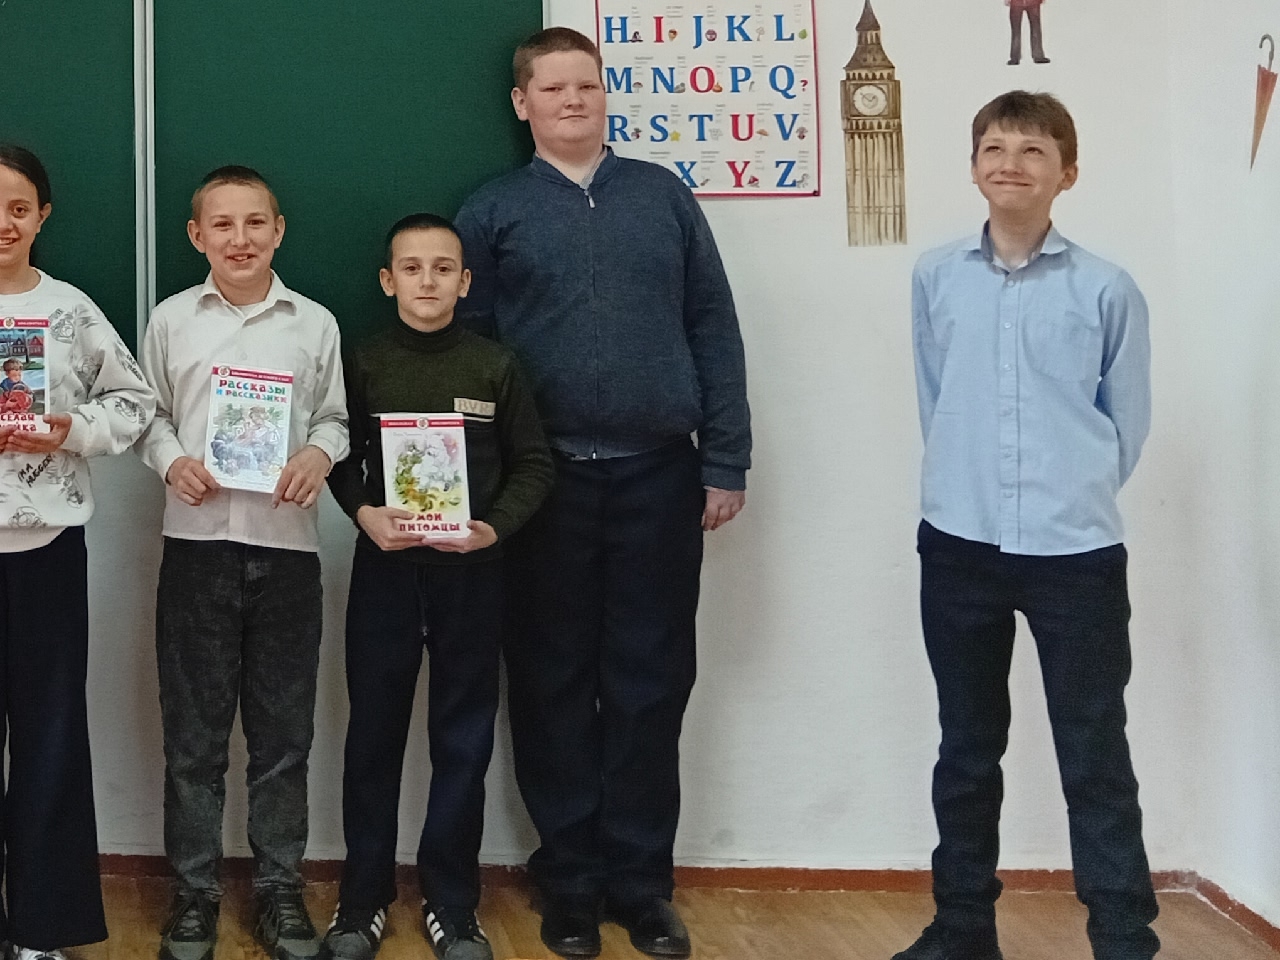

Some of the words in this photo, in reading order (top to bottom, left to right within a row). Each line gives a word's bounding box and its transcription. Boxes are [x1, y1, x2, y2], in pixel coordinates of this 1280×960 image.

[603, 16, 630, 43] H
[653, 16, 664, 43] I
[692, 15, 704, 49] J
[725, 15, 753, 42] K
[773, 14, 795, 41] L
[604, 66, 633, 93] M
[651, 66, 676, 93] N
[689, 65, 715, 93] O
[728, 66, 752, 93] P
[768, 65, 797, 99] Q
[606, 114, 632, 142] R
[649, 114, 669, 142] S
[688, 114, 713, 141] T
[730, 114, 755, 142] U
[773, 113, 799, 141] V
[674, 161, 699, 188] X
[725, 160, 751, 188] Y
[775, 160, 797, 188] Z
[399, 523, 461, 532] ПИТОМЦЫ
[416, 513, 443, 521] МОИ
